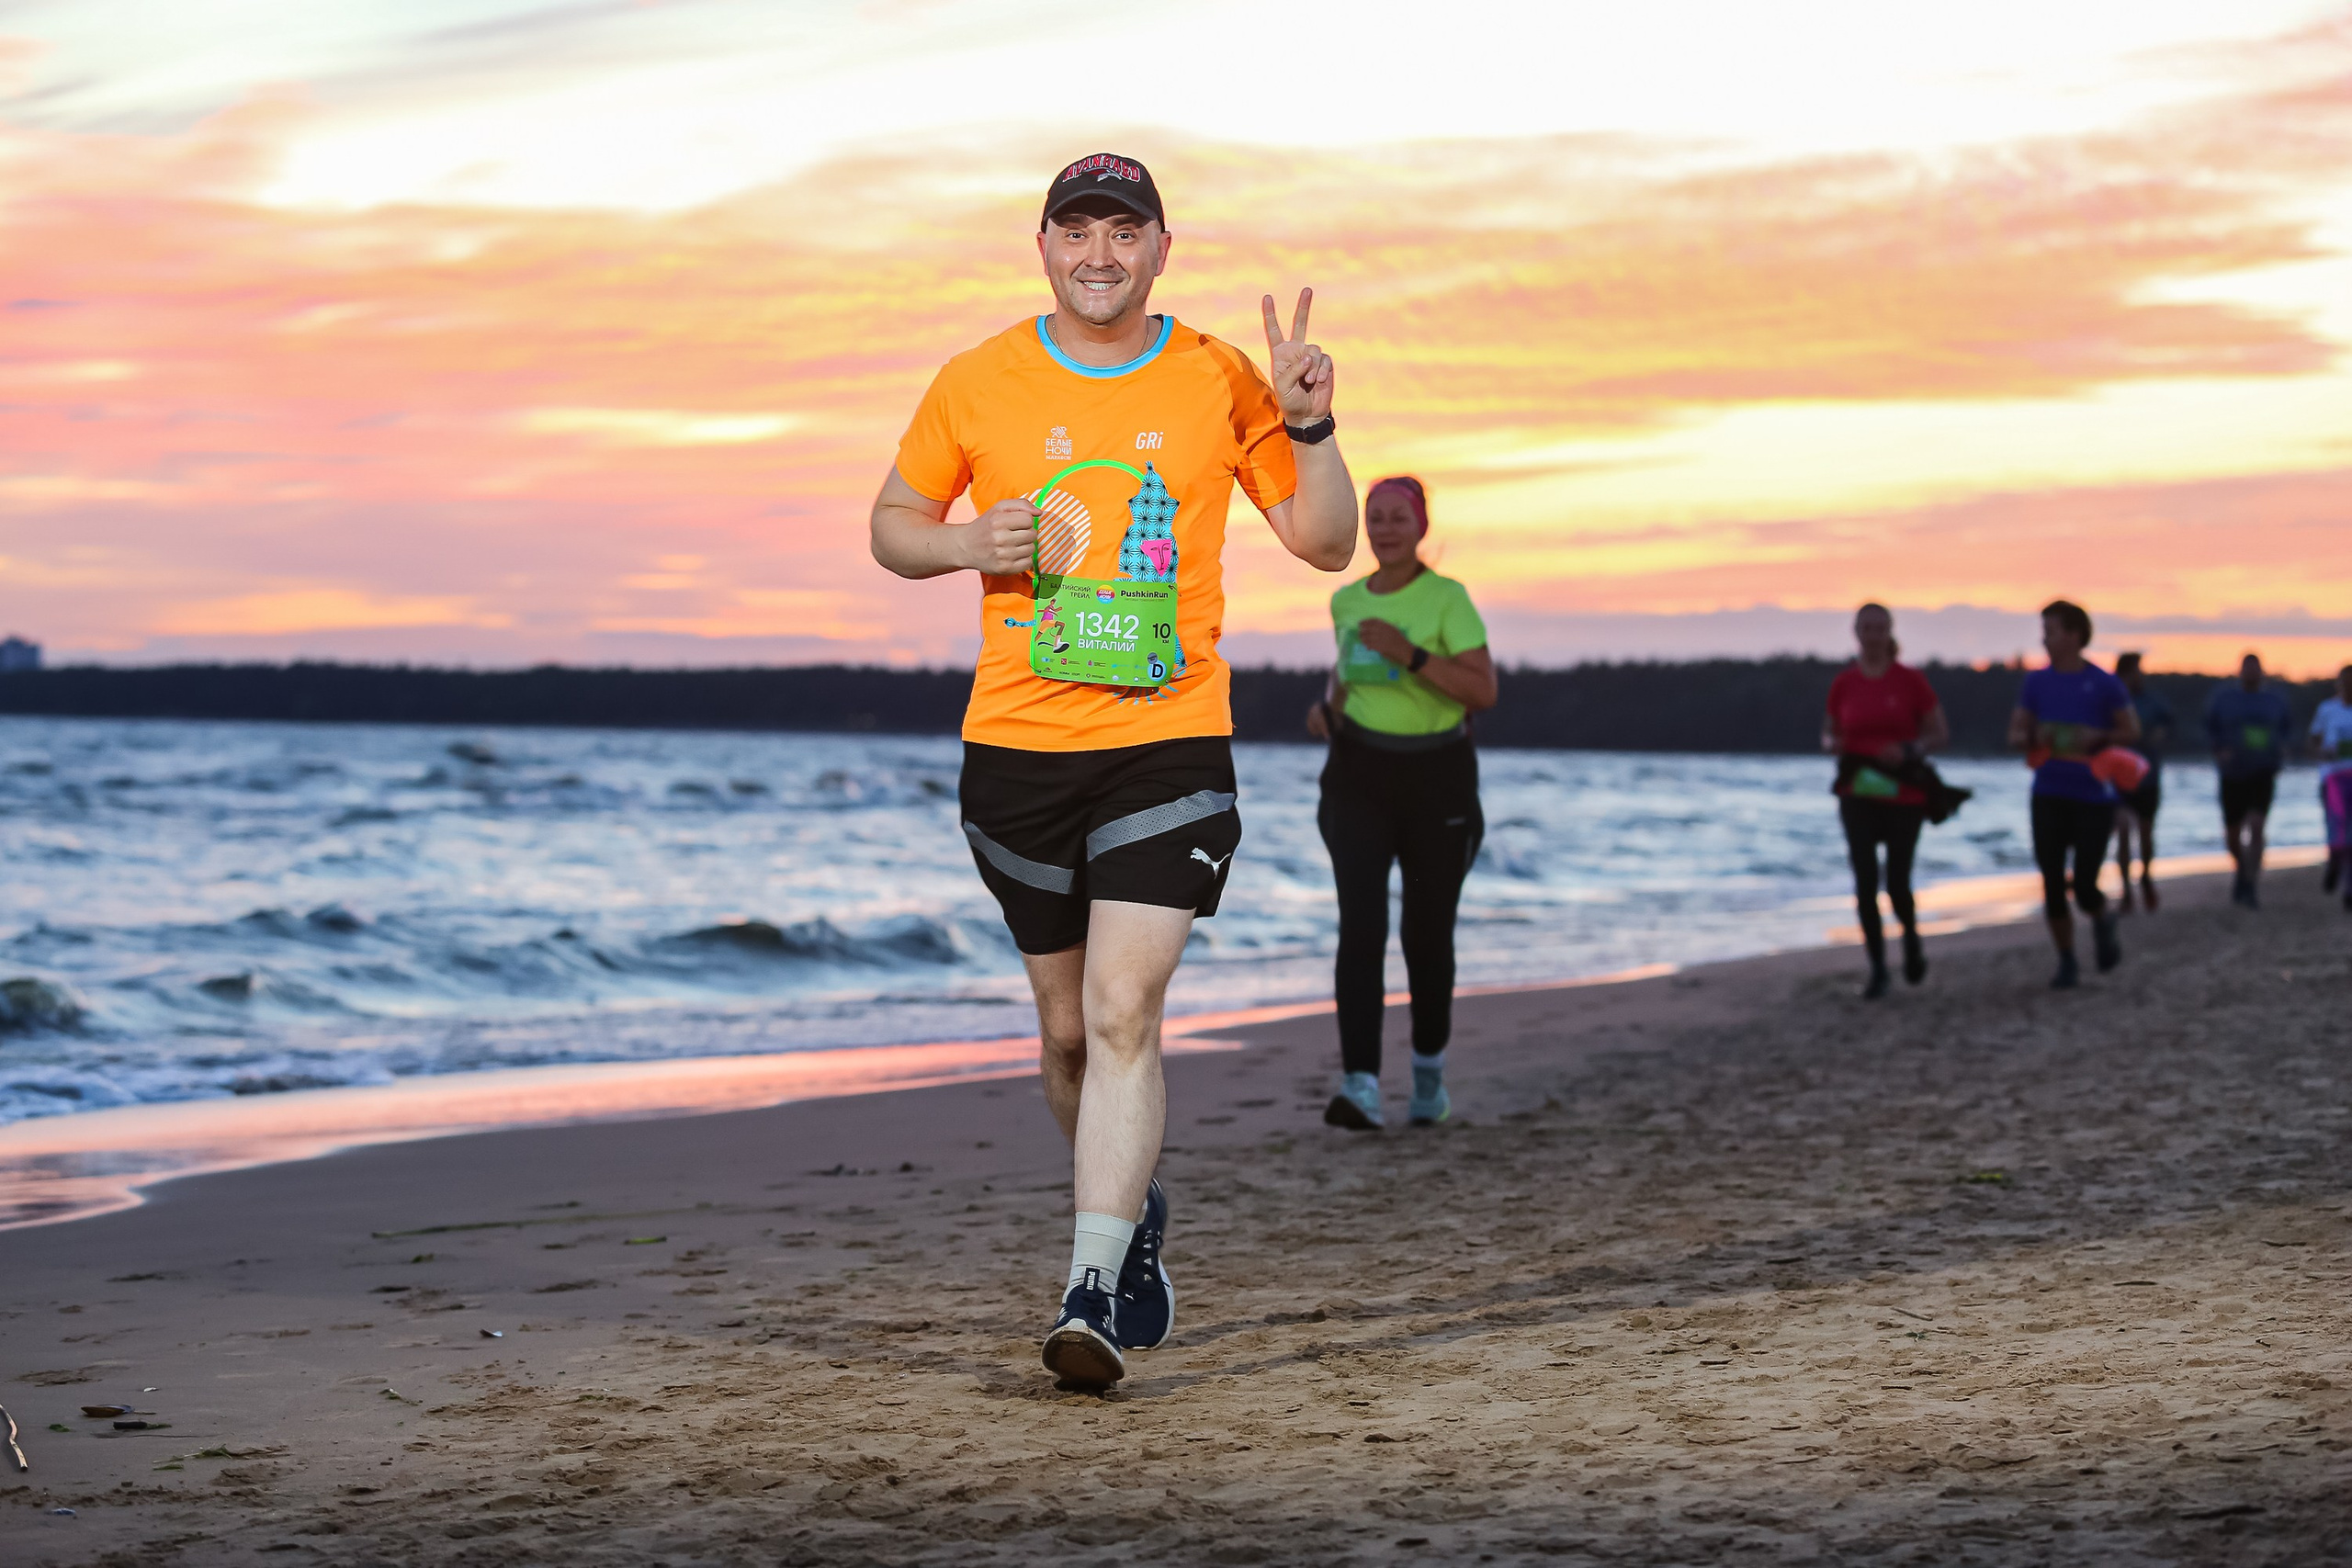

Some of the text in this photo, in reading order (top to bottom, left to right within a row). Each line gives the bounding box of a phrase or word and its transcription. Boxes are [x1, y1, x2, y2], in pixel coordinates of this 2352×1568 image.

[1046, 438, 1072, 447] БЕЛЫЕ
[1136, 432, 1164, 450] GRi
[1046, 446, 1072, 456] НОЧИ
[1050, 582, 1091, 592] БАЛТИЙСКИЙ
[1070, 591, 1091, 599] ТРЕЙЛ
[1120, 590, 1169, 599] PushkinRun
[1075, 611, 1140, 640] 1342
[1152, 623, 1171, 639] 10
[1078, 638, 1136, 652] ВИТАЛИЙ
[1151, 663, 1164, 678] D
